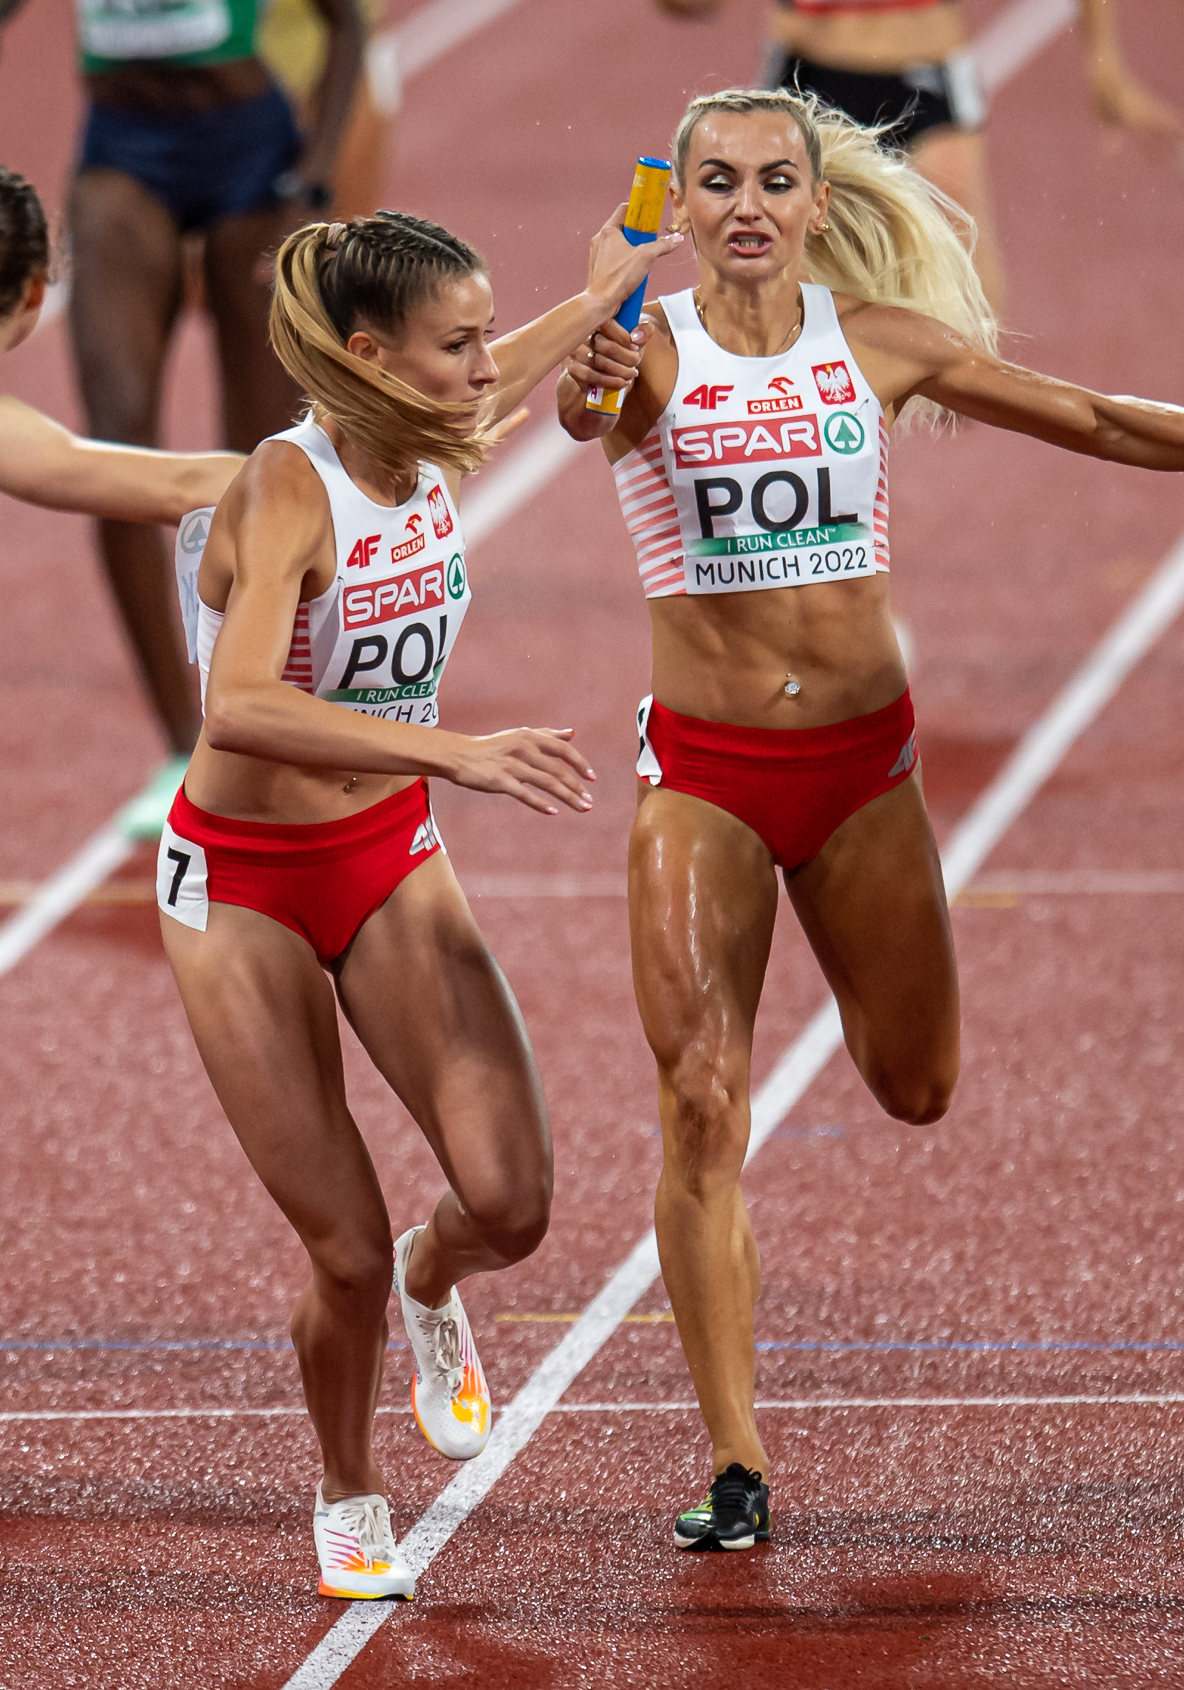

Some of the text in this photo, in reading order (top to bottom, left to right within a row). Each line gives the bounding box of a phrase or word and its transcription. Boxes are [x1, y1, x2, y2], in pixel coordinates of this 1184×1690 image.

[683, 384, 734, 410] 4F
[750, 398, 800, 413] ORLEN
[677, 420, 818, 462] SPAR
[694, 467, 858, 539] POL
[347, 534, 382, 569] 4F
[392, 536, 424, 561] ORLEN
[726, 542, 731, 554] I
[737, 536, 773, 553] RUN
[695, 546, 868, 586] MUNICH 2022
[346, 568, 443, 624] SPAR
[357, 684, 436, 702] I RUN CLEA
[167, 846, 192, 907] 7
